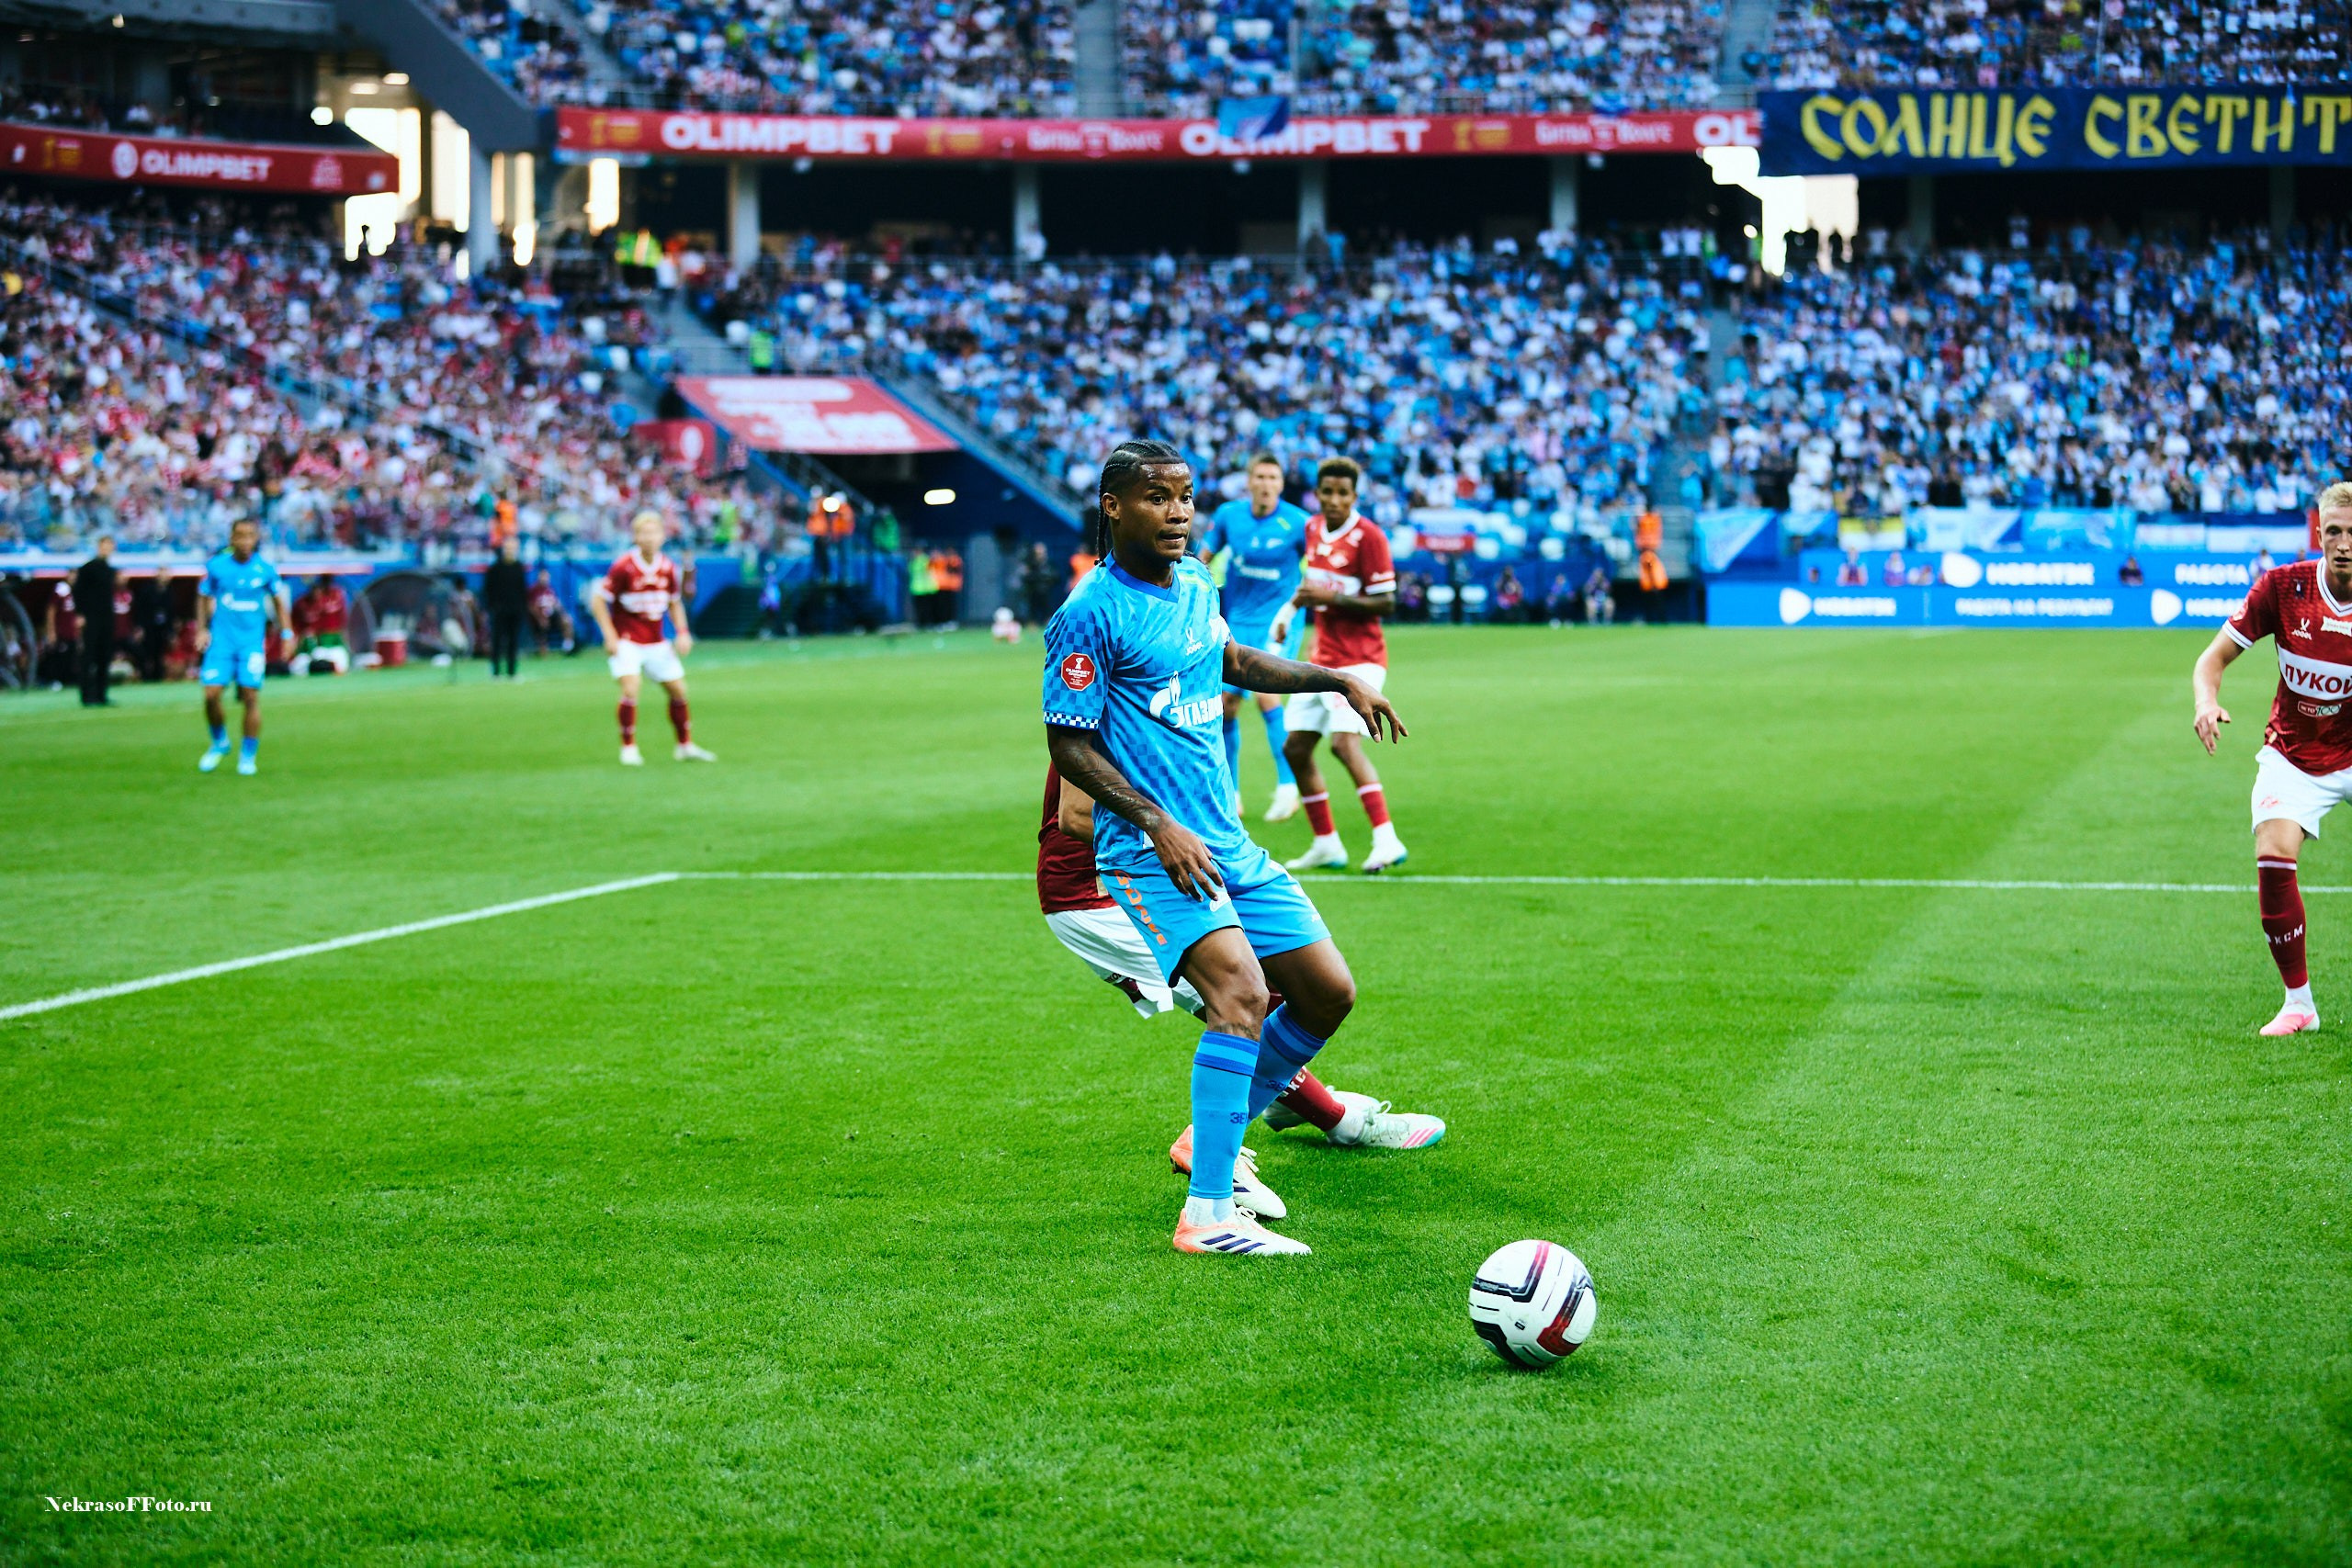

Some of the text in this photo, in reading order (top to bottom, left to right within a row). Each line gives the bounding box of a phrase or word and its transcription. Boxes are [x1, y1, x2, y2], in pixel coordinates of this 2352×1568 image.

[662, 115, 901, 154] OLIMPBET
[1801, 94, 2352, 167] СОЛНЦЕ СВЕТИТ
[141, 149, 272, 182] OLIMPBET
